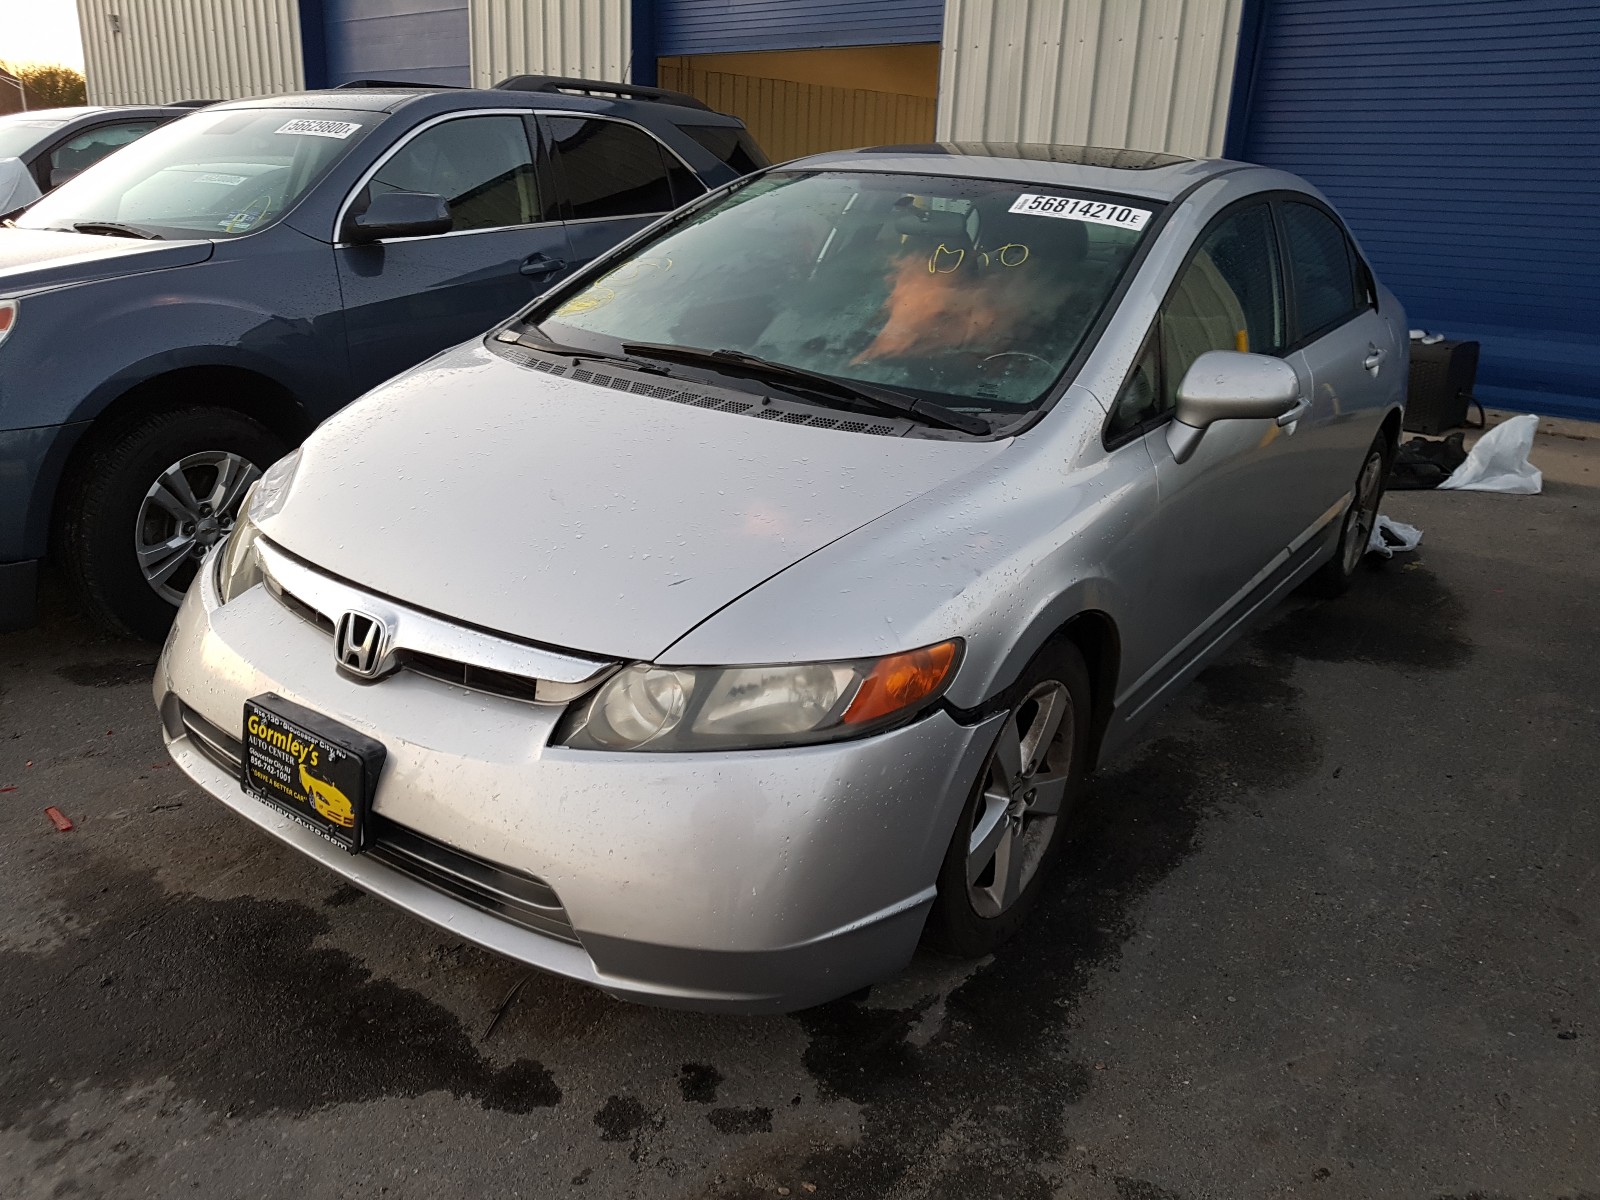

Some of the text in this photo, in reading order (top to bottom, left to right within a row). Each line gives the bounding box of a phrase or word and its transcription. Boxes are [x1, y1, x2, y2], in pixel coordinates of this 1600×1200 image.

[247, 715, 319, 767] Gormley's
[248, 734, 295, 766] AUTO CENTER
[282, 721, 319, 746] Gloucester
[336, 749, 347, 760] NJ
[249, 747, 274, 765] Gloucester
[250, 755, 291, 783] 856-742-1001
[273, 780, 293, 797] BETTER
